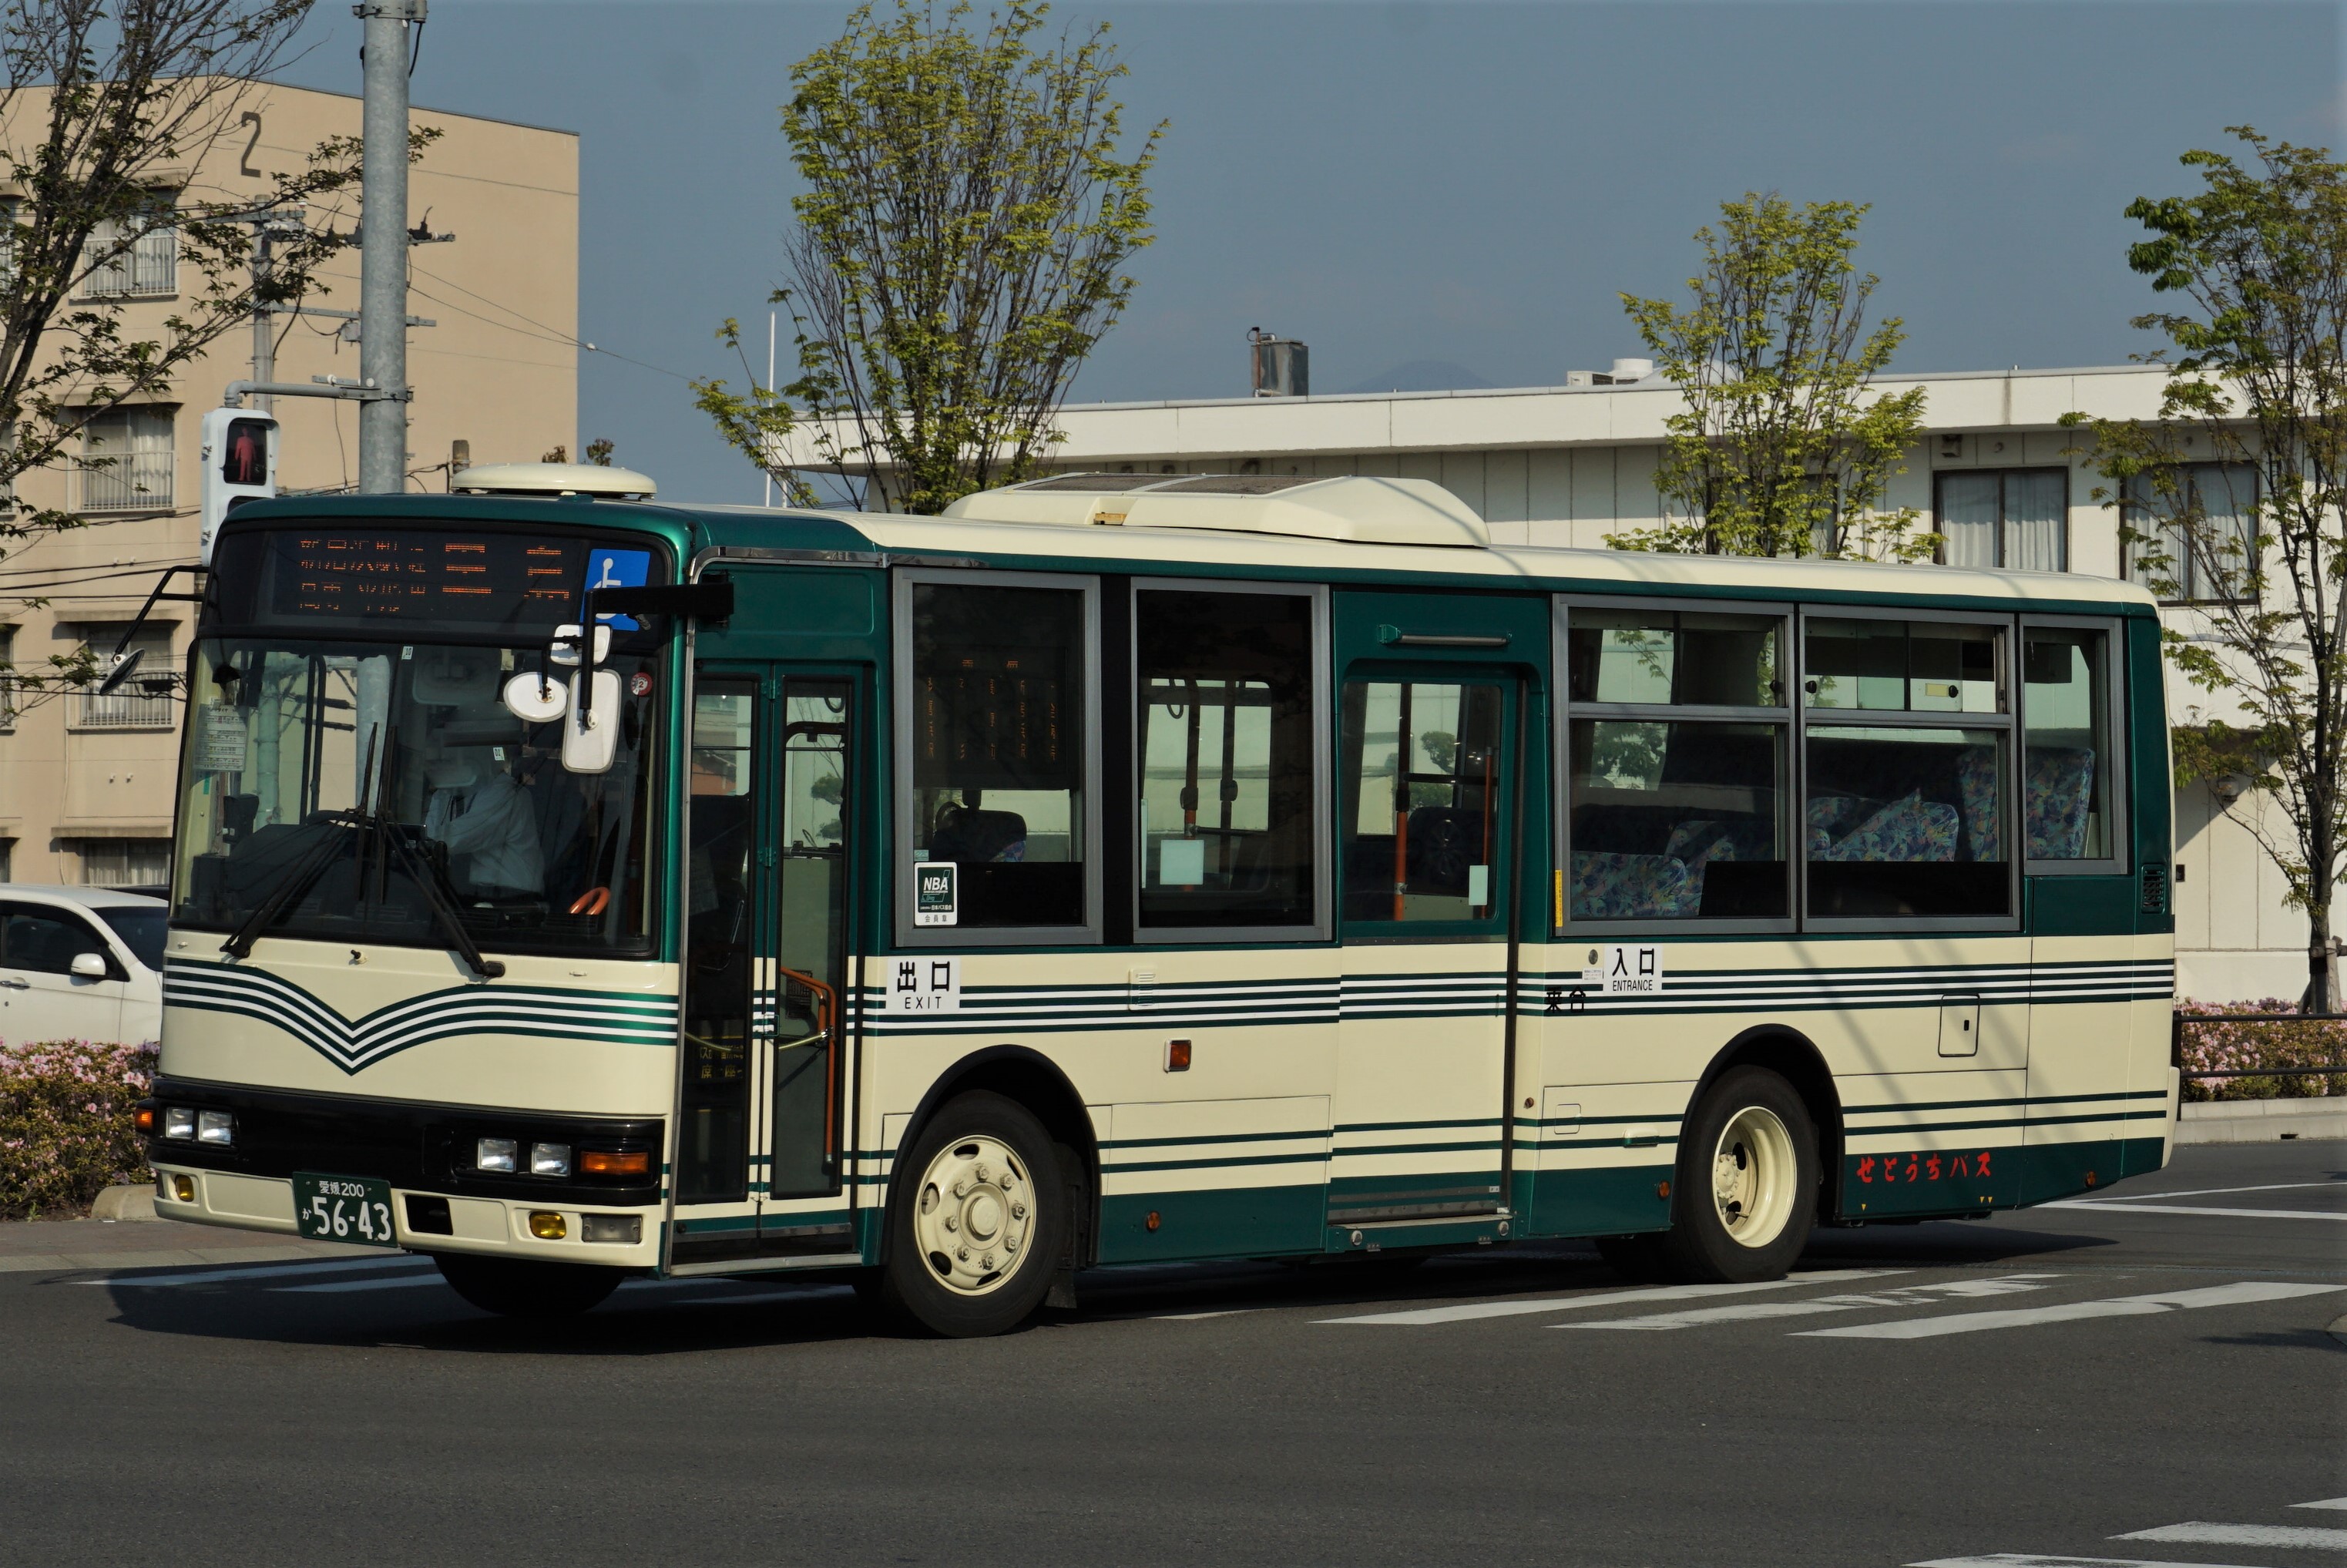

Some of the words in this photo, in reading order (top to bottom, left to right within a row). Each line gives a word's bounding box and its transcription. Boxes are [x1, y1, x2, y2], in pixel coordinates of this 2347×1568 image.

[241, 111, 261, 178] 2
[923, 877, 949, 891] NBA
[1612, 948, 1654, 976] 入口
[897, 961, 950, 992] 出口
[1613, 979, 1653, 992] ENTRANCE
[905, 996, 942, 1009] EXIT
[1546, 986, 1586, 1013] 乗合
[1856, 1151, 1991, 1184] せとうちバス
[302, 1207, 312, 1220] か
[312, 1196, 391, 1241] 56-43
